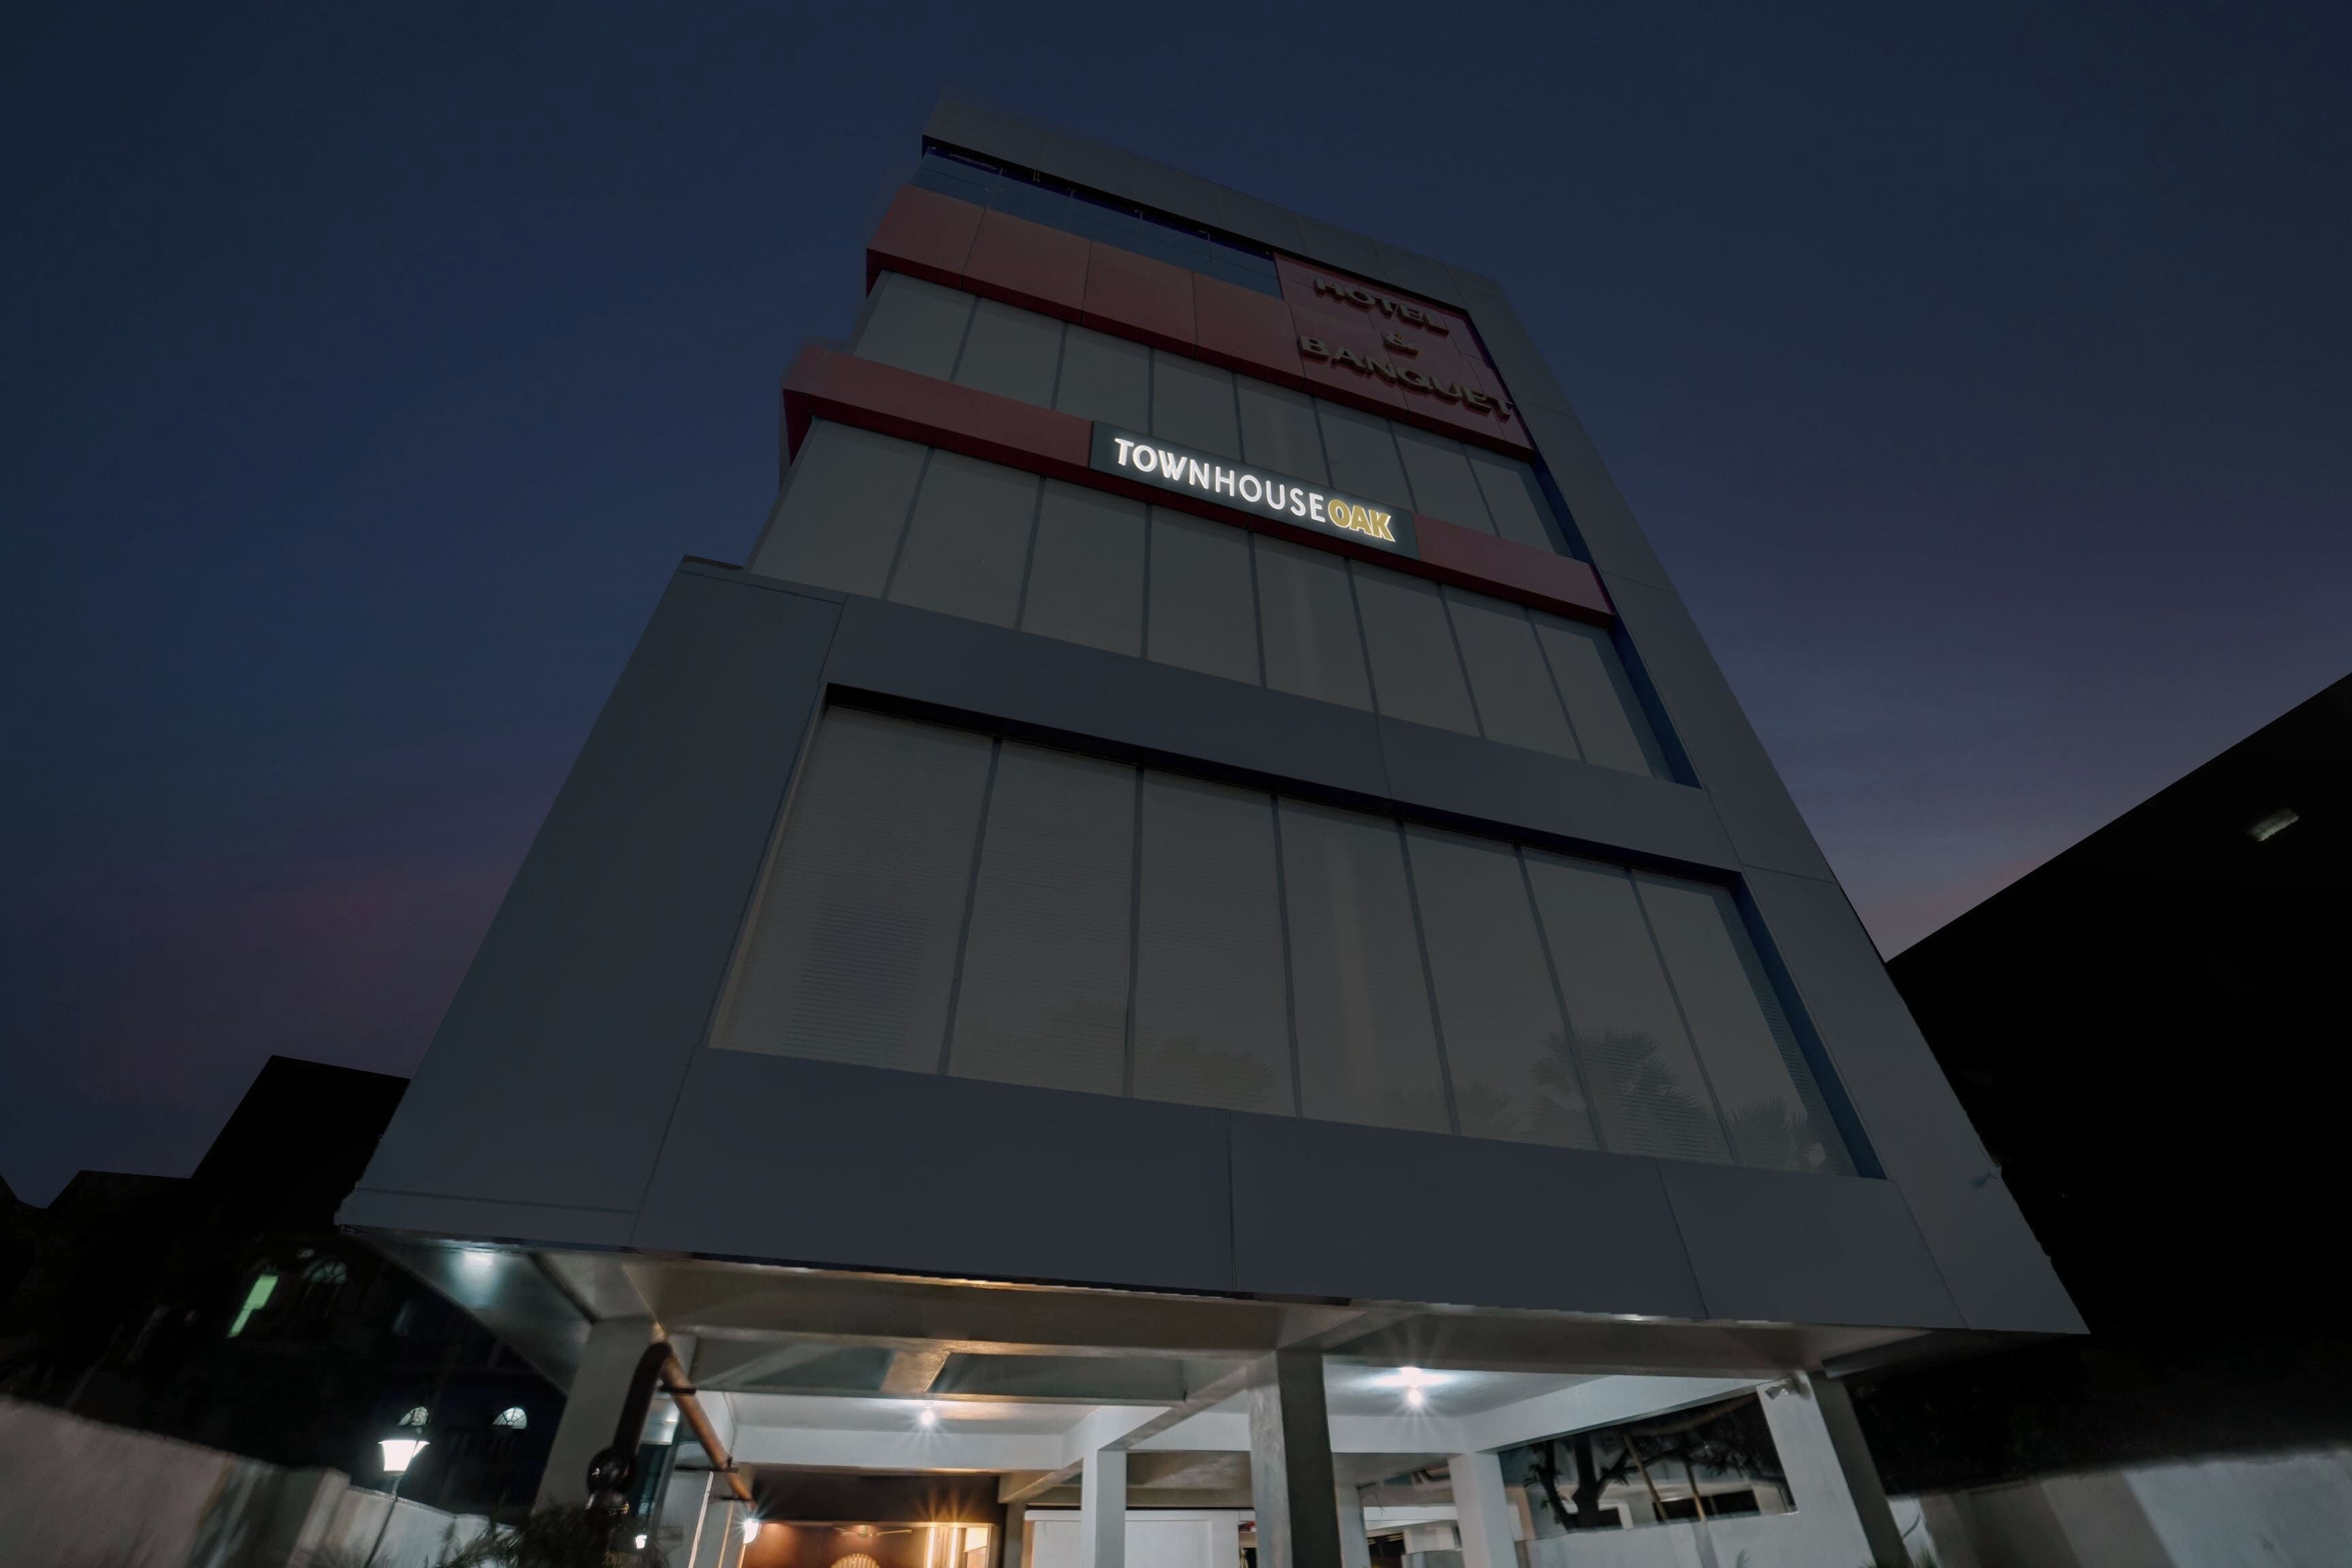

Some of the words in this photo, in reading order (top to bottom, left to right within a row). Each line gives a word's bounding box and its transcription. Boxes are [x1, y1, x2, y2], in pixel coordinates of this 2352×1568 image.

[1314, 276, 1449, 336] HOTEL
[1384, 331, 1418, 356] &
[1298, 334, 1515, 420] BANQUET
